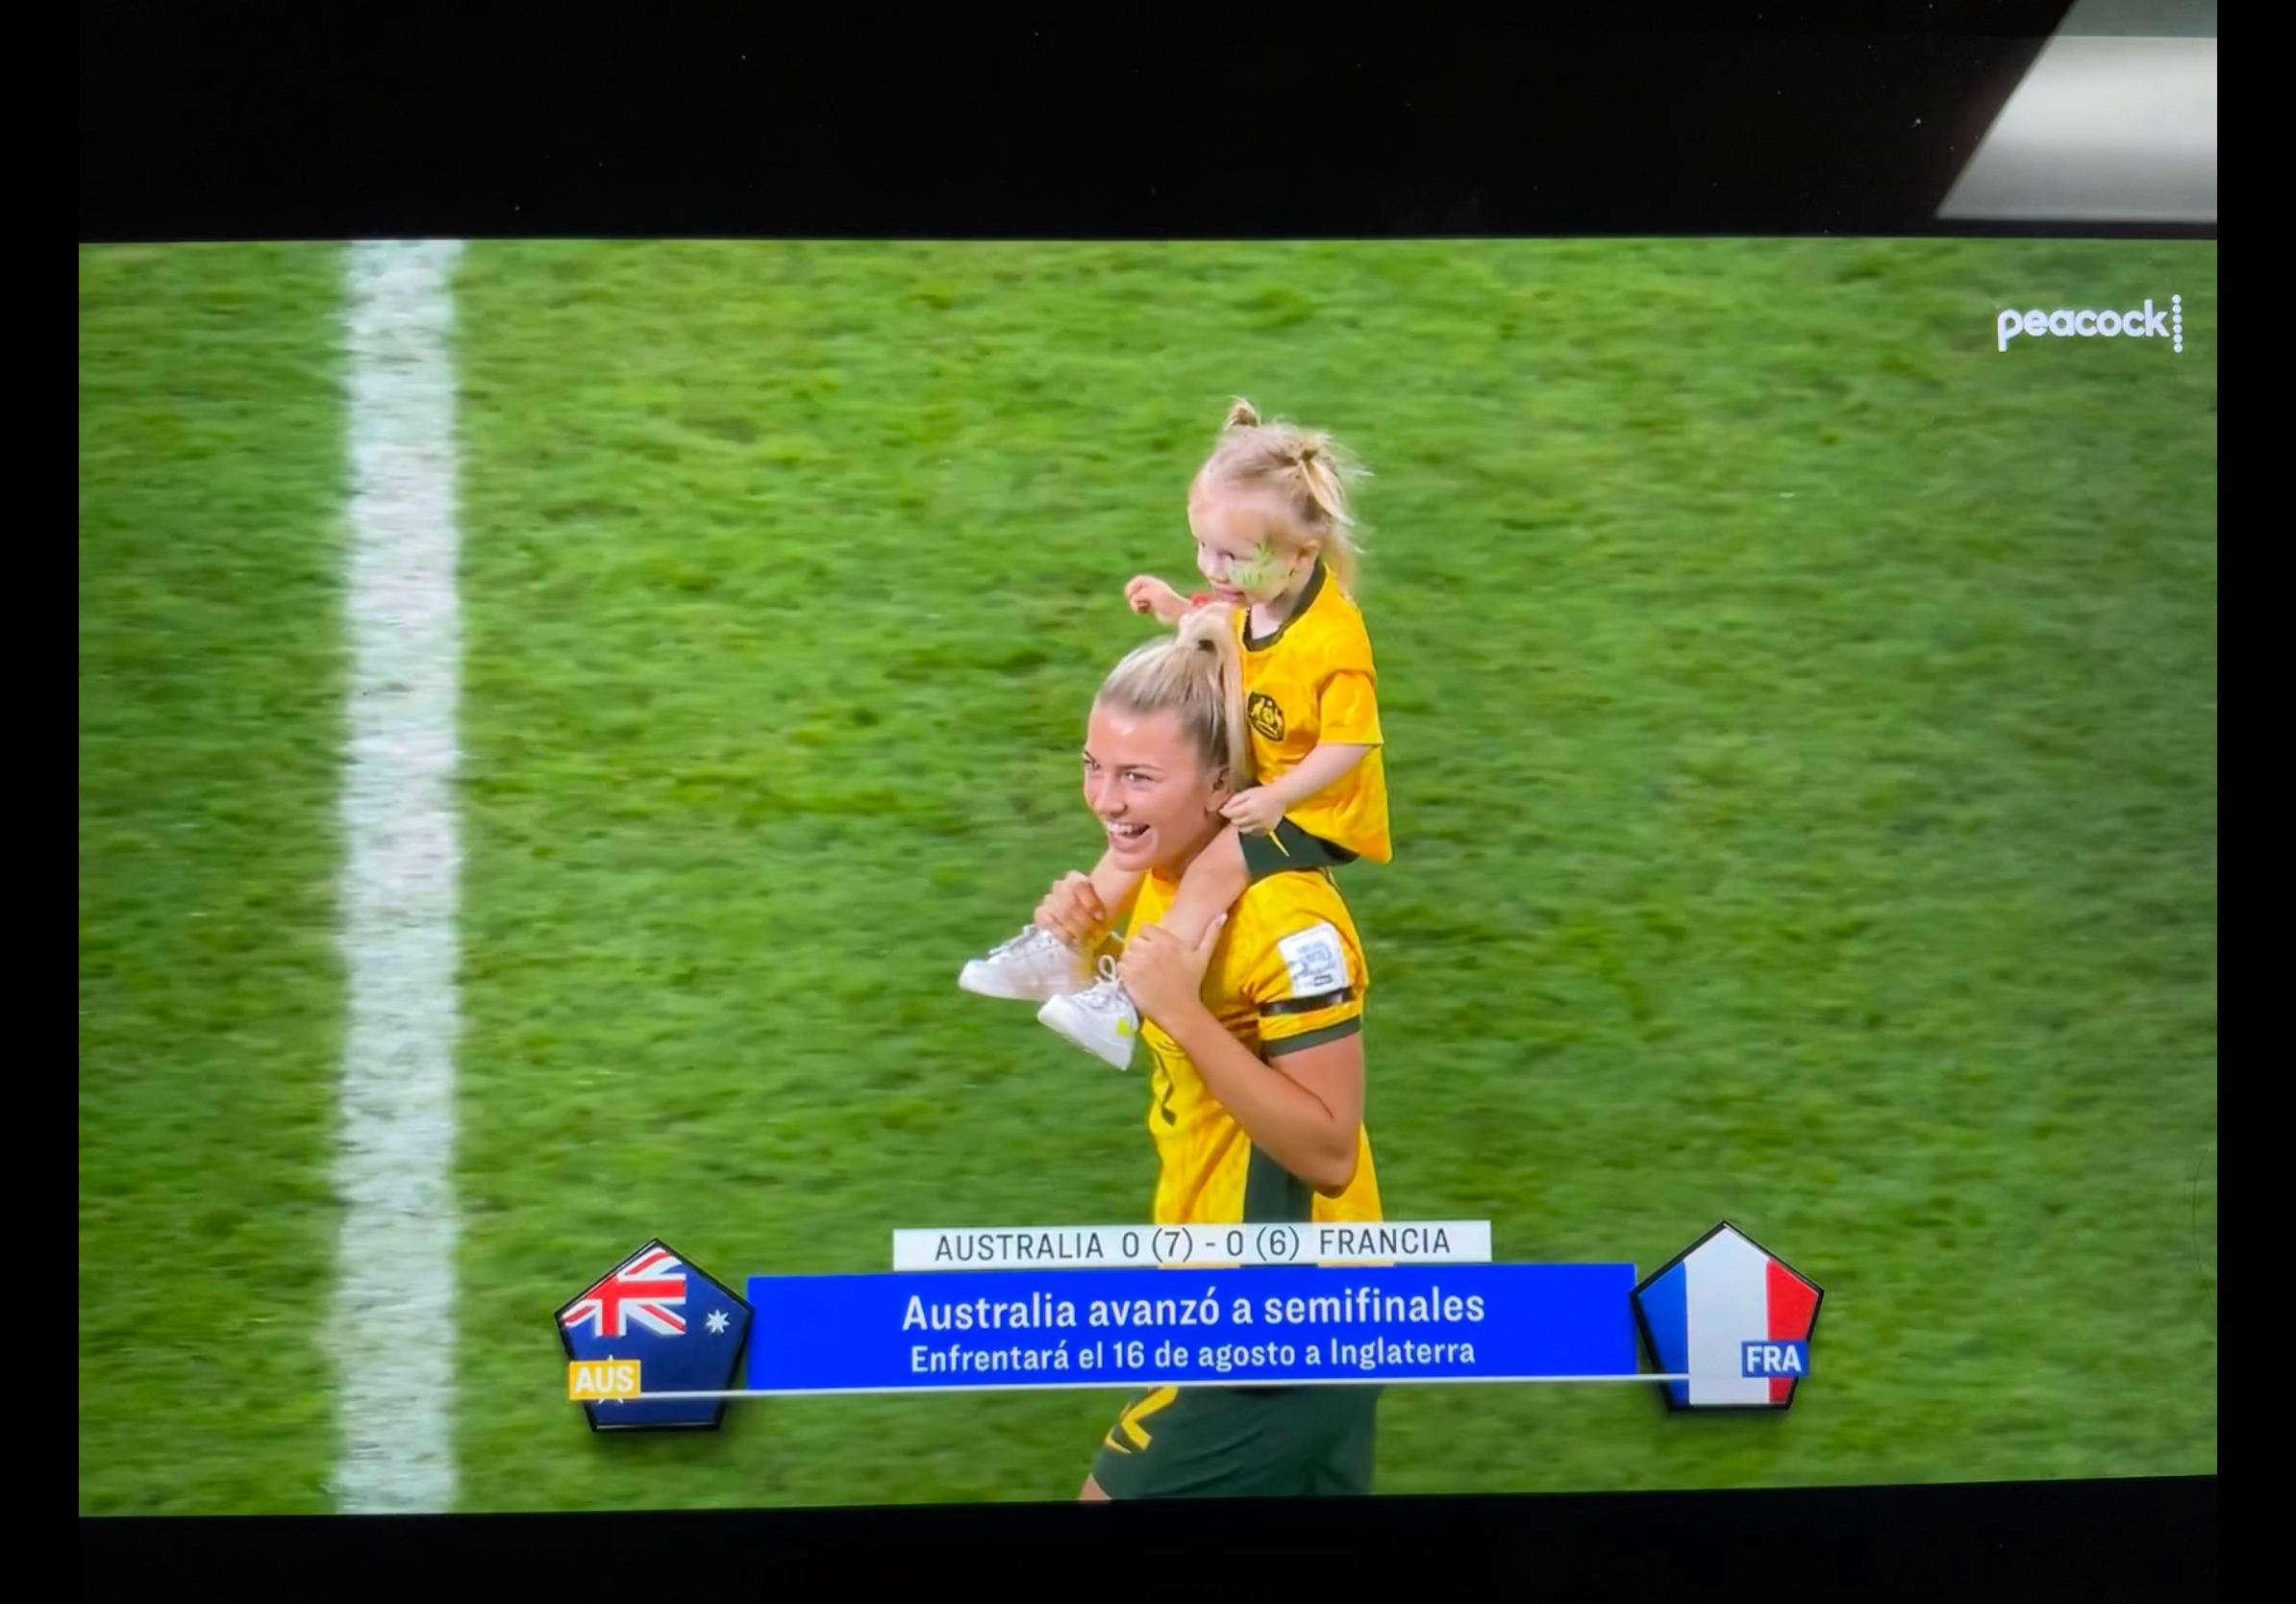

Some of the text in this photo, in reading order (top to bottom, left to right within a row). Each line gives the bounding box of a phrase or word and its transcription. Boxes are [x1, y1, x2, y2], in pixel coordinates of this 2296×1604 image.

[1997, 298, 2170, 352] peacock
[935, 1233, 1104, 1262] AUSTRALIA
[1122, 1231, 1138, 1259] 0
[1151, 1227, 1193, 1264] (7)
[1226, 1230, 1244, 1257] 0
[1256, 1226, 1301, 1262] (6)
[1319, 1227, 1451, 1256] FRANCIA
[902, 1286, 1485, 1331] Australia avanzó a semifinales
[911, 1337, 1476, 1373] Enfrentará el 16 de agosto a Inglaterra
[1747, 1344, 1803, 1373] FRA
[576, 1366, 635, 1393] AUS
